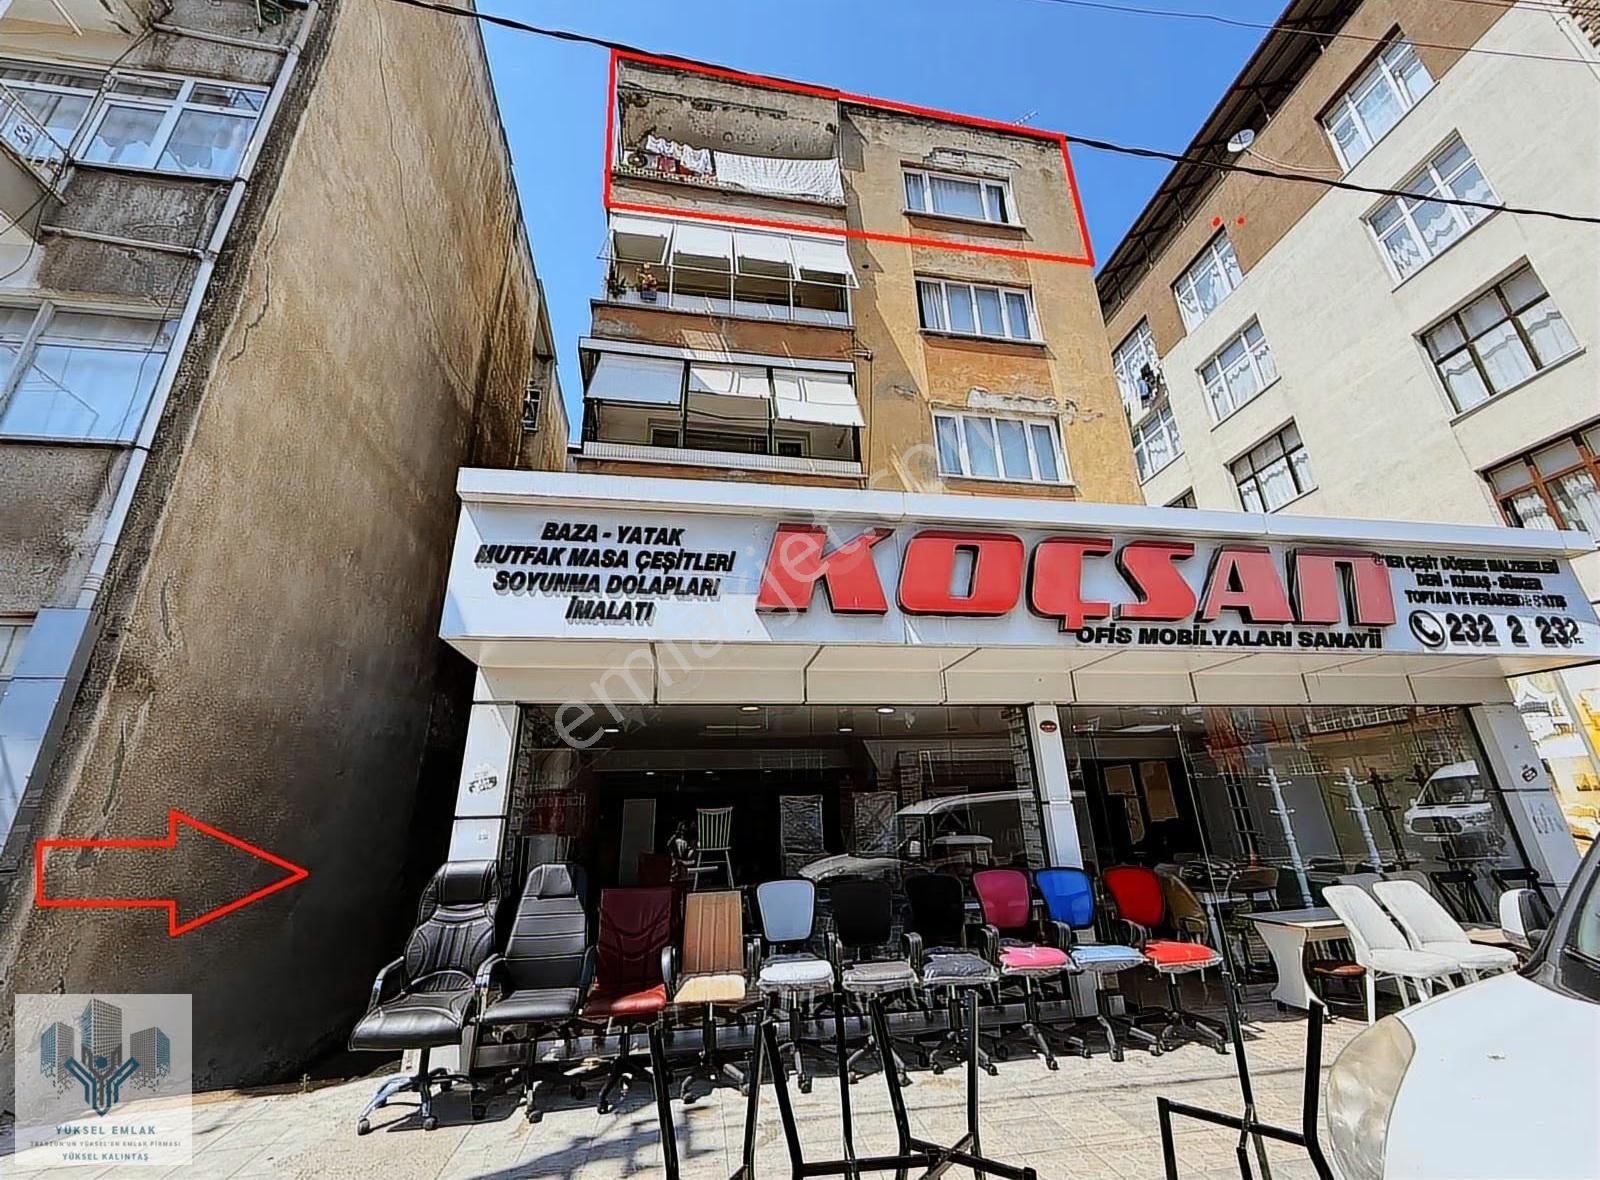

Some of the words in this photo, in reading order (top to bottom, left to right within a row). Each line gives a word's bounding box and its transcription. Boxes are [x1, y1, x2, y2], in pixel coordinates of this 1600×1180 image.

[541, 521, 598, 543] BAZA
[617, 525, 685, 547] YATAK
[474, 544, 563, 567] MUTFAK
[567, 547, 630, 569] MASA
[635, 548, 736, 574] ÇEŞİTLERİ
[493, 571, 601, 594] SOYUNMA
[605, 574, 720, 596] DOLAPLARI
[756, 523, 1396, 632] KOÇSAN
[565, 596, 656, 621] İMALATI
[1453, 592, 1470, 605] VE
[1076, 622, 1132, 644] OFİS
[1138, 624, 1292, 648] MOBİLYALARI
[1446, 614, 1499, 642] 232
[1507, 615, 1527, 643] 2
